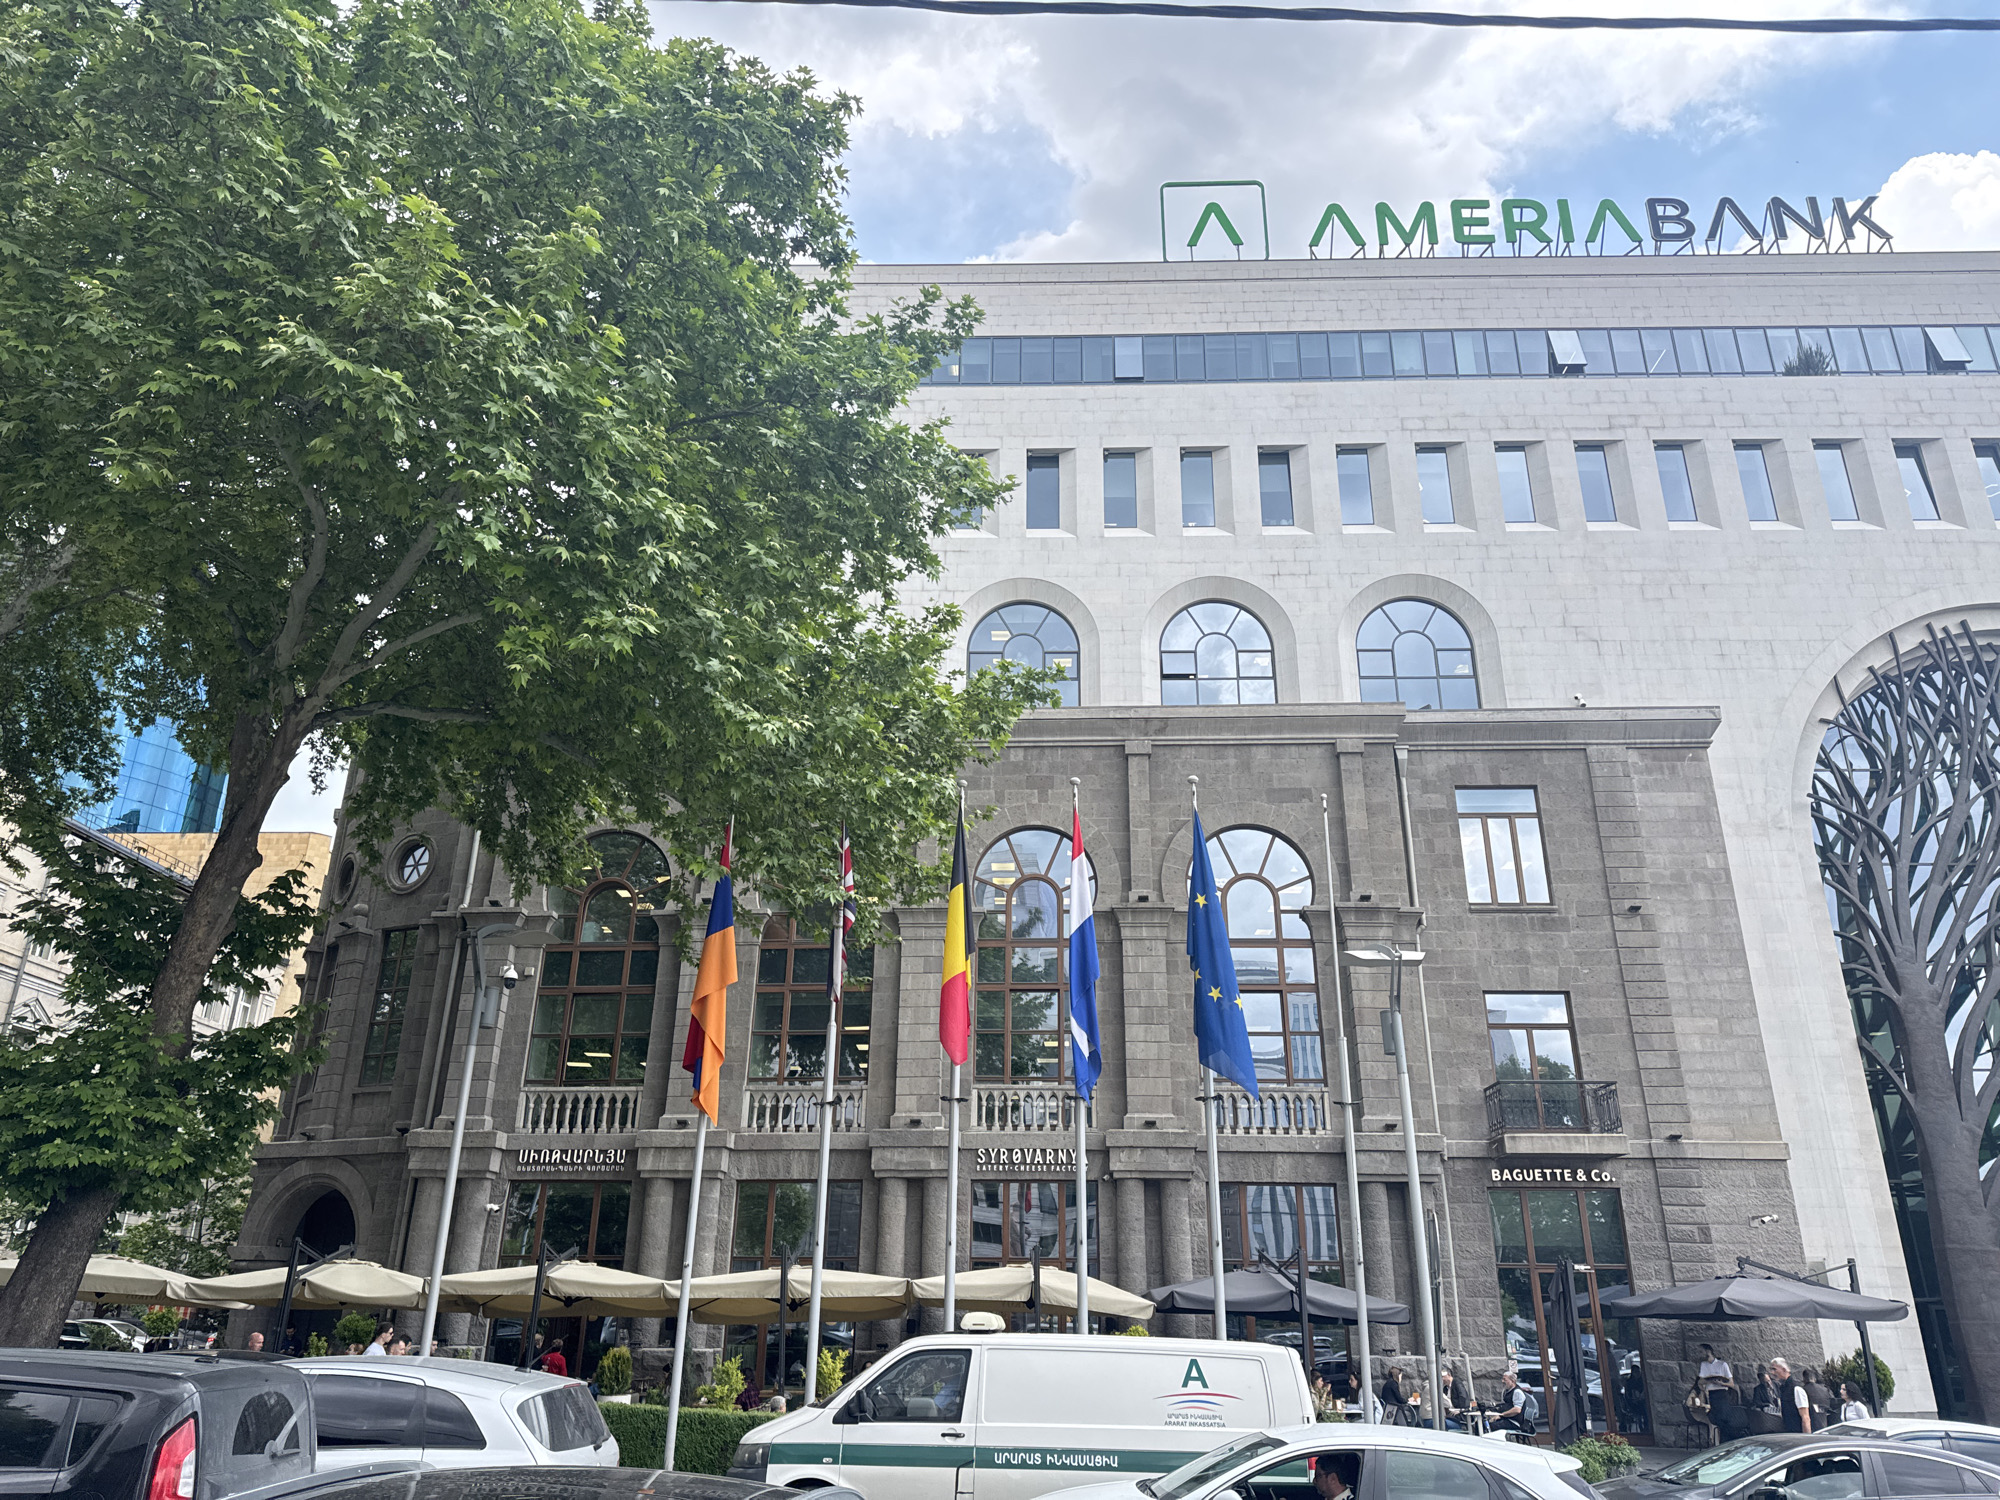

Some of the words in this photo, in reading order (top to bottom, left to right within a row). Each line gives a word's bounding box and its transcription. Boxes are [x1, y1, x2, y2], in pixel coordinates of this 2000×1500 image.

[1491, 1168, 1573, 1182] BAGUETTE
[1576, 1168, 1588, 1182] &
[1591, 1169, 1617, 1182] Co.
[994, 1452, 1042, 1465] ԱՐԱՐԱՏ
[1046, 1454, 1118, 1468] ԻՆԿԱՍԱՑԻԱ
